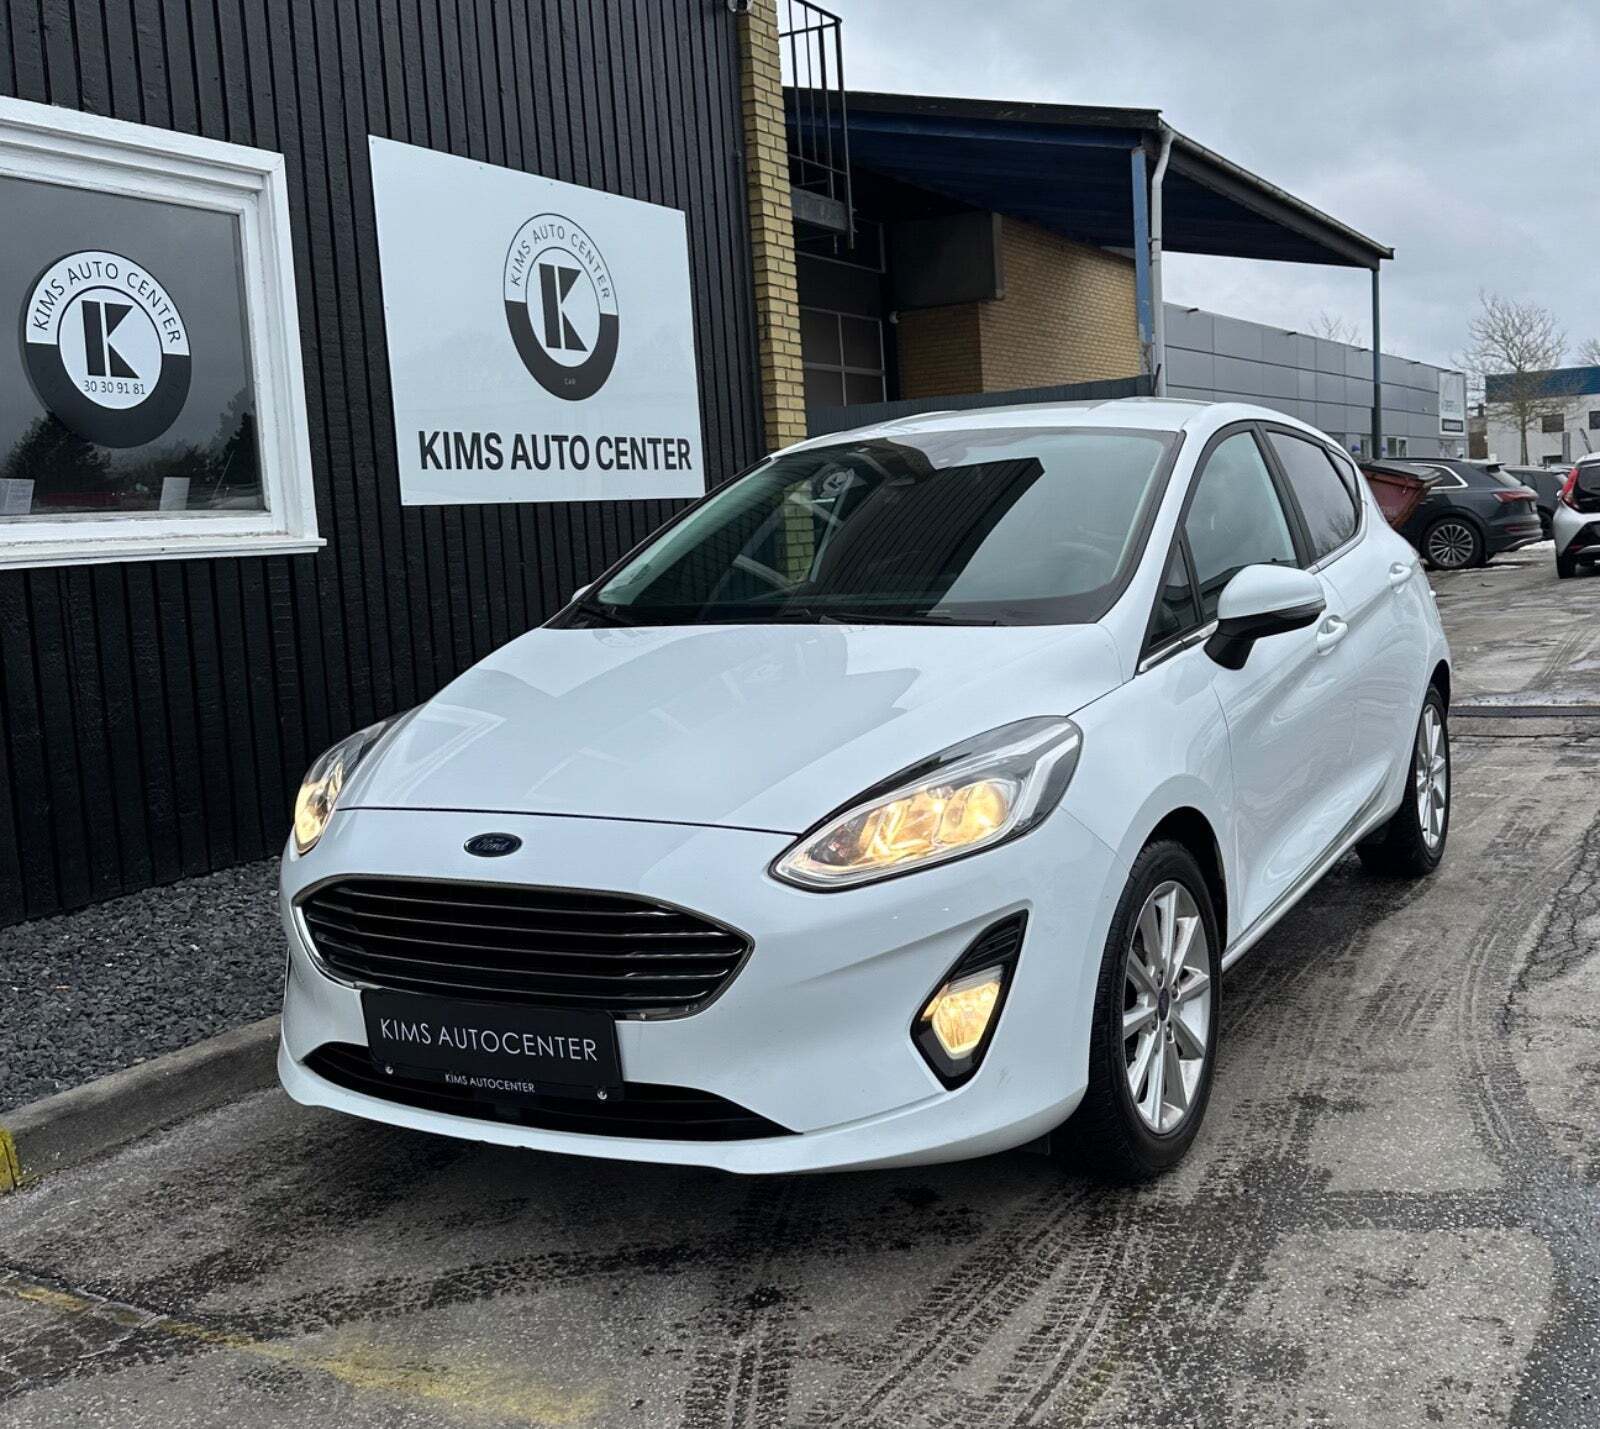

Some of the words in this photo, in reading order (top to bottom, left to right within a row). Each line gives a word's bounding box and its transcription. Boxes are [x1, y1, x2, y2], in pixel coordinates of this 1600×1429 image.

[510, 240, 532, 287] KIMS
[532, 224, 565, 245] AUTO
[570, 233, 611, 299] CENTER
[32, 278, 65, 331] KIMS
[67, 261, 119, 285] AUTO
[126, 272, 181, 344] CENTER
[538, 262, 589, 353] K
[80, 299, 141, 380] K
[84, 380, 98, 393] 30
[100, 381, 115, 394] 30
[116, 382, 130, 394] 91
[133, 383, 146, 395] 81
[418, 430, 504, 471] KIMS
[510, 433, 590, 471] AUTO
[595, 435, 693, 471] CENTER
[380, 1018, 432, 1045] KIMS
[438, 1026, 598, 1062] AUTOCENTER
[445, 1073, 468, 1086] KIMS
[469, 1077, 536, 1093] AUTOCENTER
